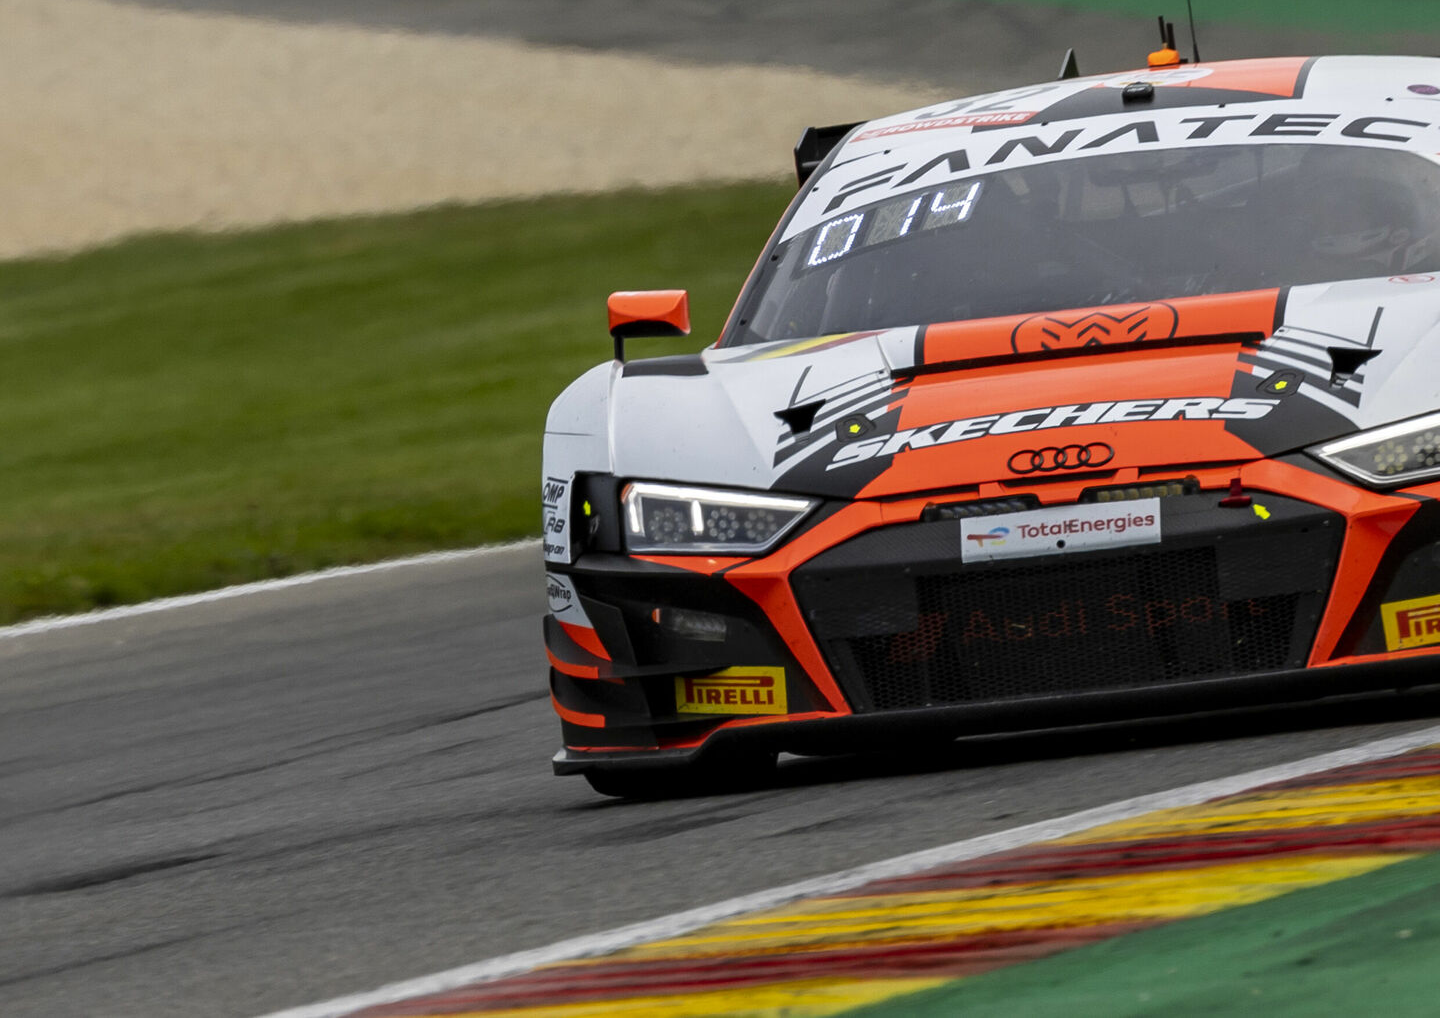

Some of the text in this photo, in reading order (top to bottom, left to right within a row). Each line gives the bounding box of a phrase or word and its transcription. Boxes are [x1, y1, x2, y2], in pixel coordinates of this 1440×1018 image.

[823, 113, 1431, 216] FANATEC
[807, 182, 981, 266] 014
[825, 397, 1281, 471] SKECHERS
[1016, 512, 1155, 539] TotalEnergies
[684, 675, 775, 705] PIRELLI
